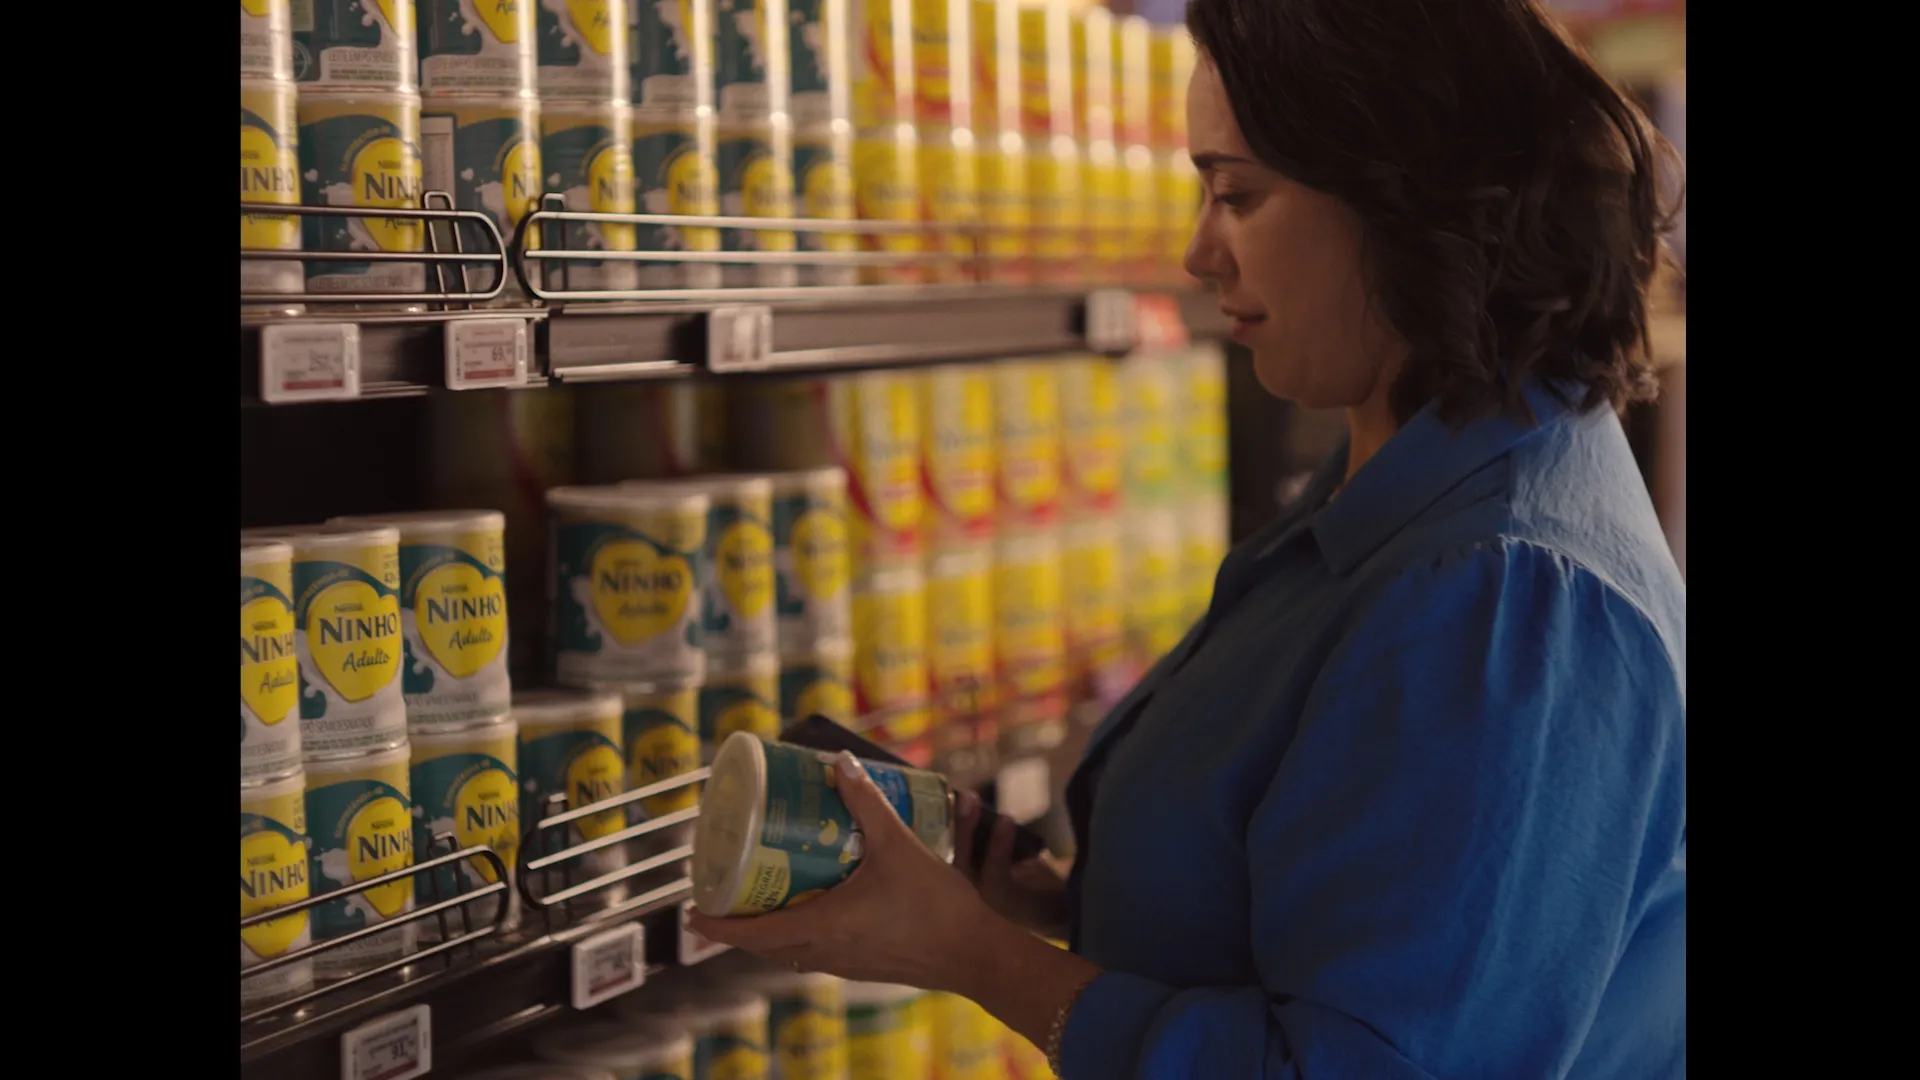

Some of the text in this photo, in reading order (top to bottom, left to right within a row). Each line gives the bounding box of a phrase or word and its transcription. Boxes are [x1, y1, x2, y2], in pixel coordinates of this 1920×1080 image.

[241, 166, 296, 192] INHO
[364, 171, 421, 200] NINH
[600, 569, 682, 594] NINHO
[426, 593, 502, 625] NINHO
[319, 612, 397, 645] NINHO
[241, 632, 294, 665] NINH
[342, 649, 391, 673] Adulto
[357, 829, 412, 862] NINH
